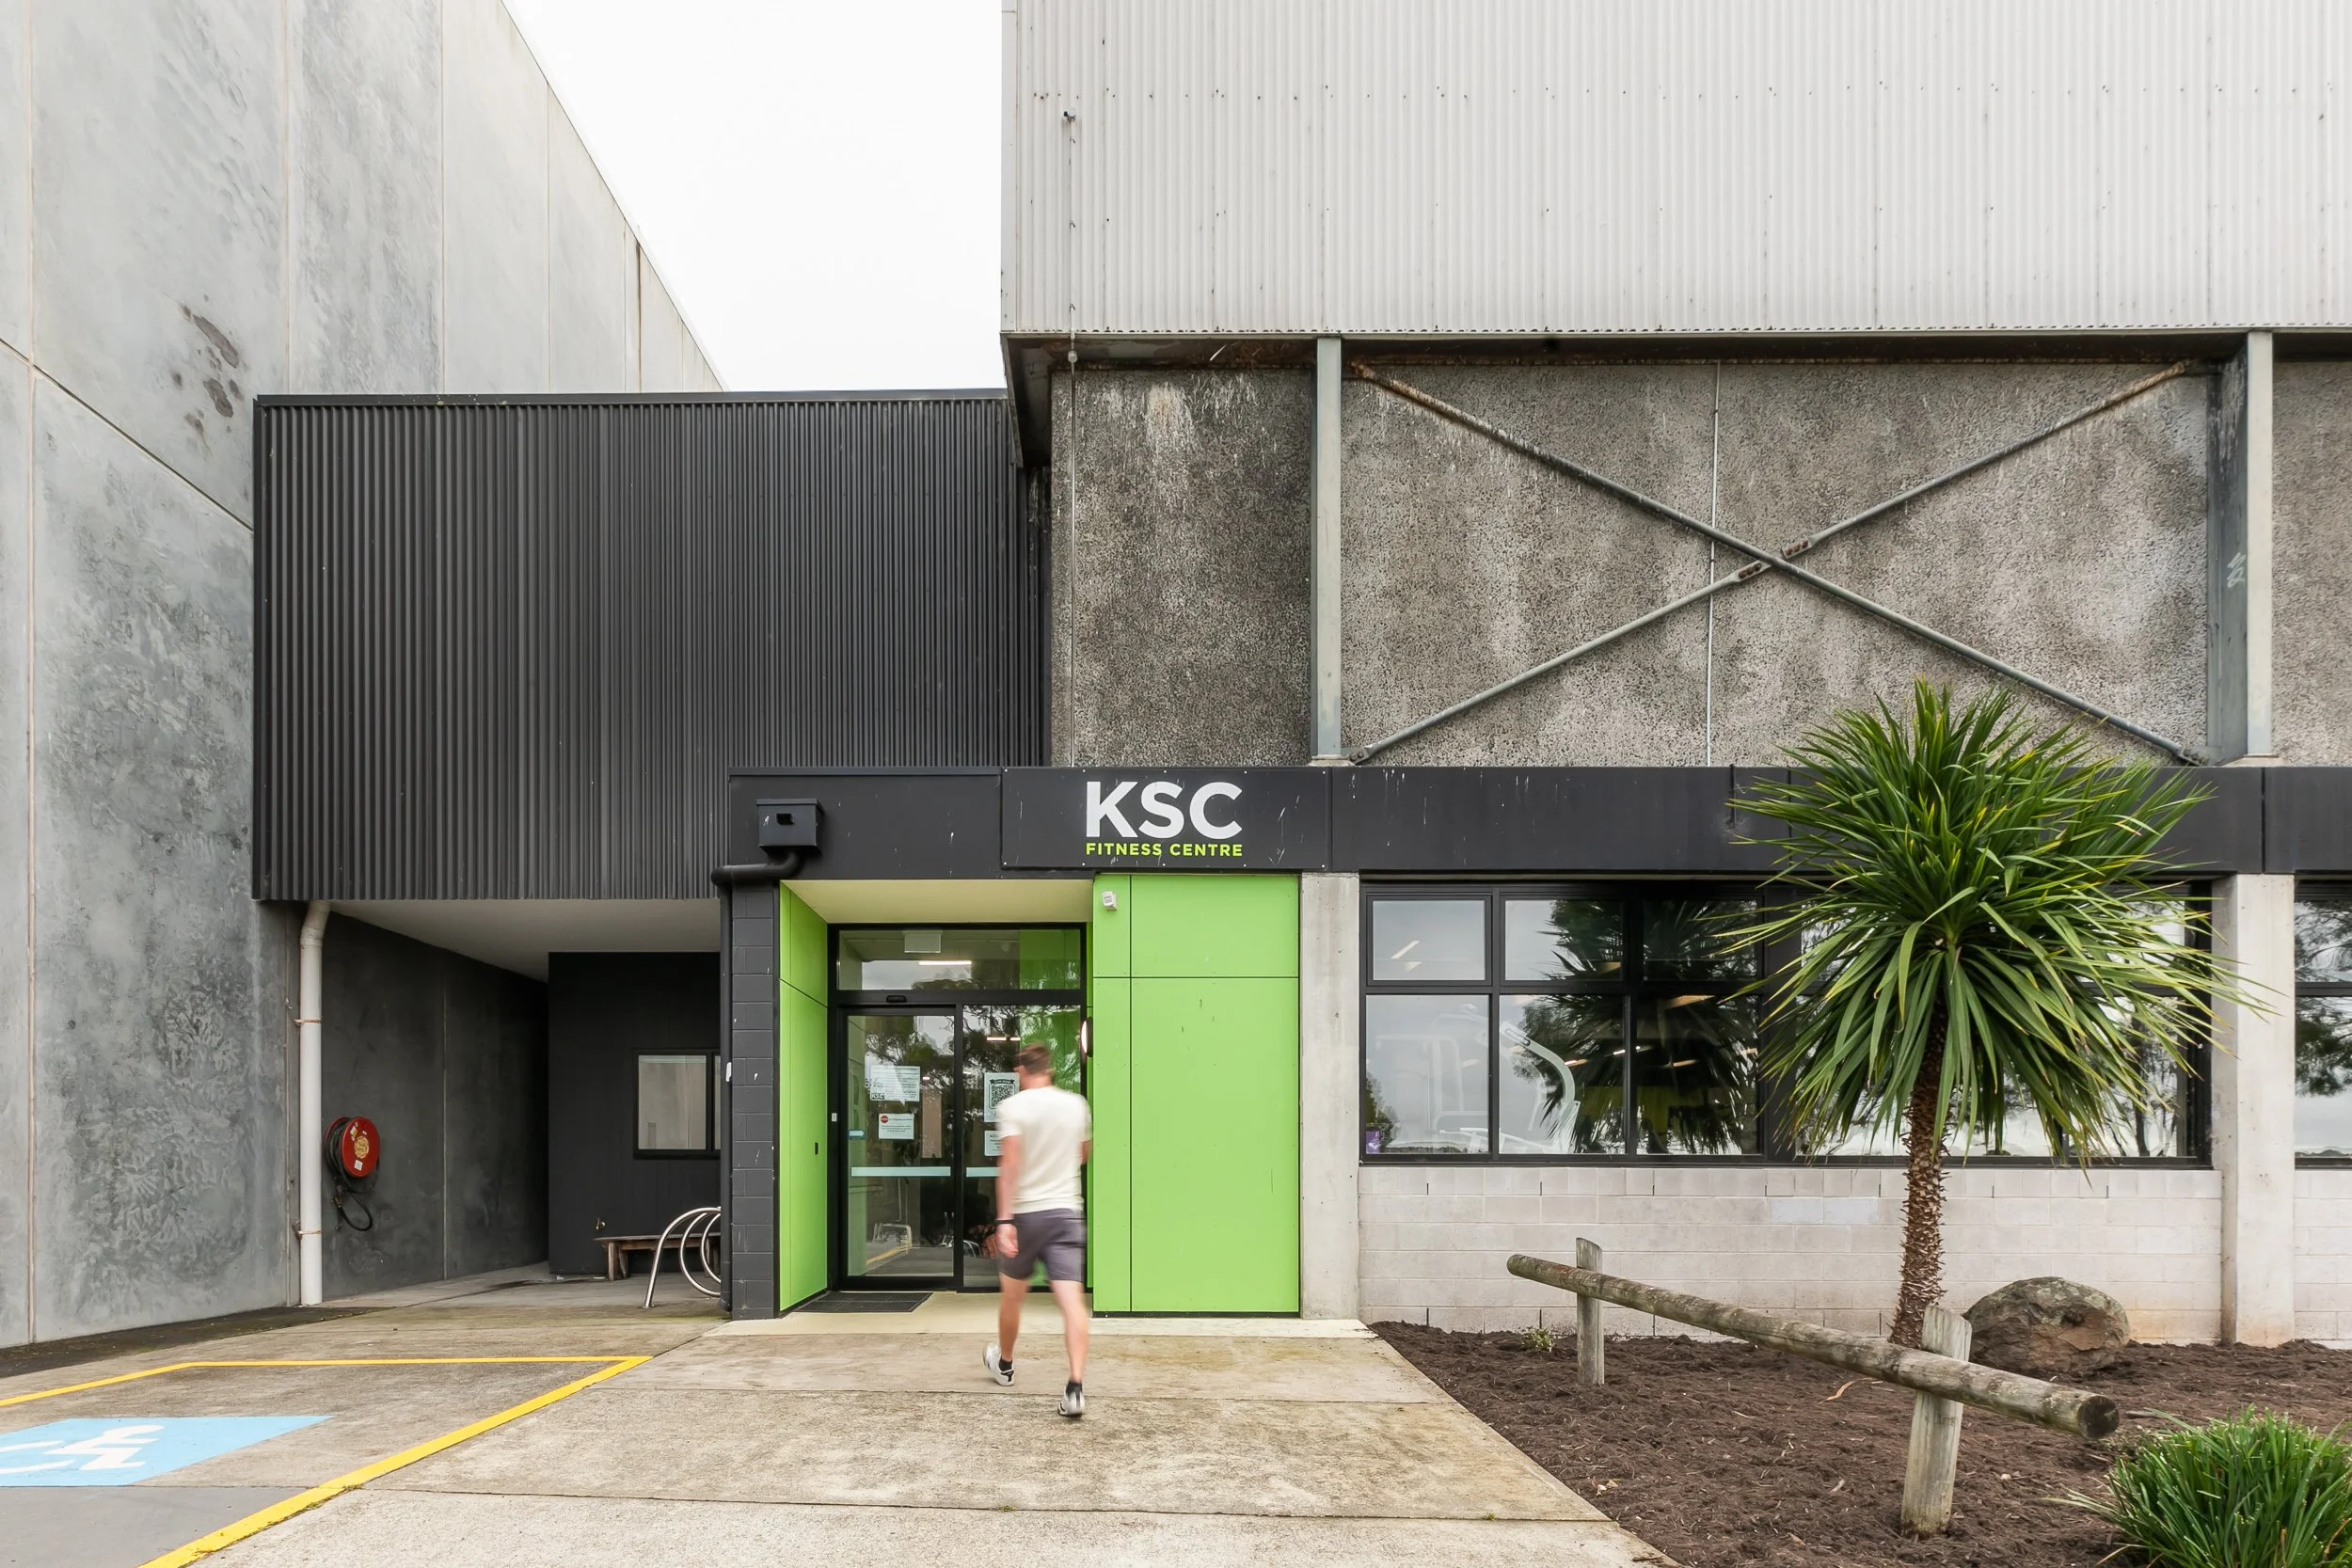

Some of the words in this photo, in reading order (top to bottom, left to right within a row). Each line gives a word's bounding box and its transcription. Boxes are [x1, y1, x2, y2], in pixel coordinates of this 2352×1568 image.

[1086, 781, 1243, 840] KSC
[1086, 843, 1163, 856] FITNESS
[1168, 843, 1243, 857] CENTRE
